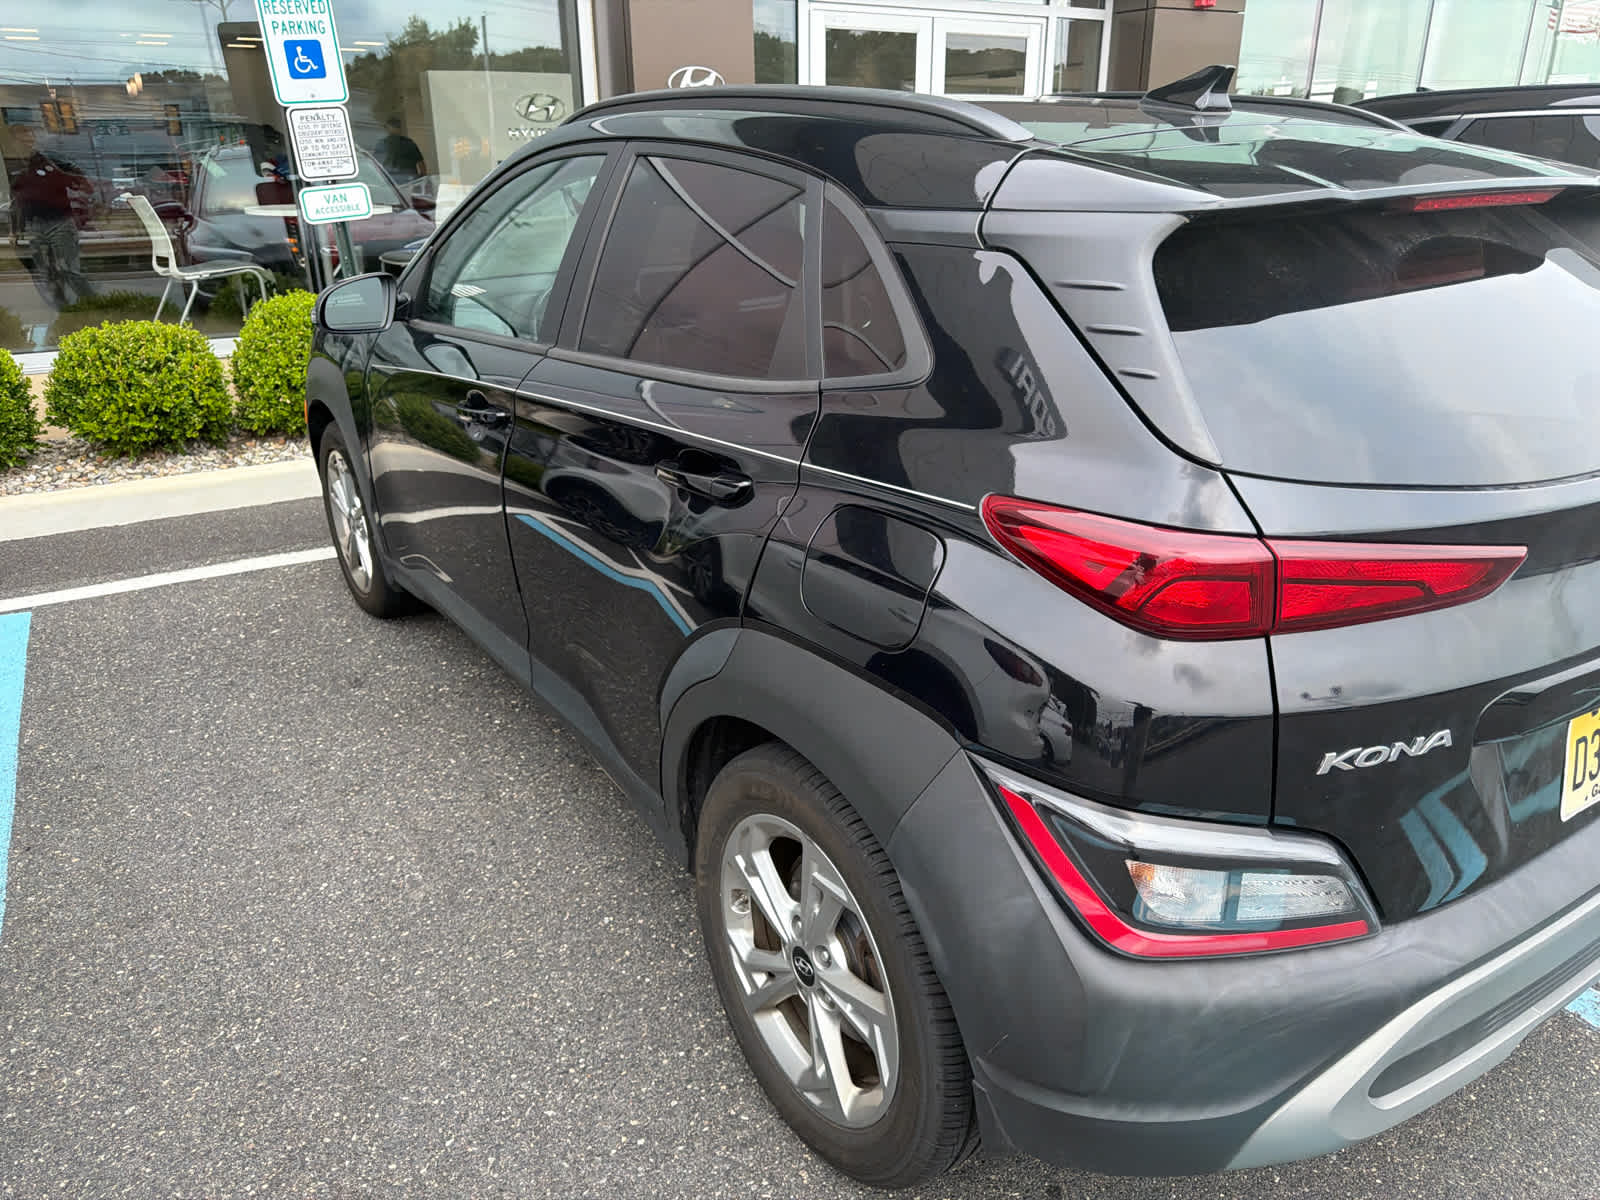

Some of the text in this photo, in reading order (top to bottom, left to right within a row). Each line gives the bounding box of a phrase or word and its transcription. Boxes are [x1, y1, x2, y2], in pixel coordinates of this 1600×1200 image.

[262, 0, 327, 15] RESERVED
[271, 20, 326, 35] PARKING
[299, 113, 336, 121] PENALTY
[323, 193, 348, 204] VAN
[315, 203, 361, 216] ACCESSIBLE
[1316, 728, 1453, 776] KONA
